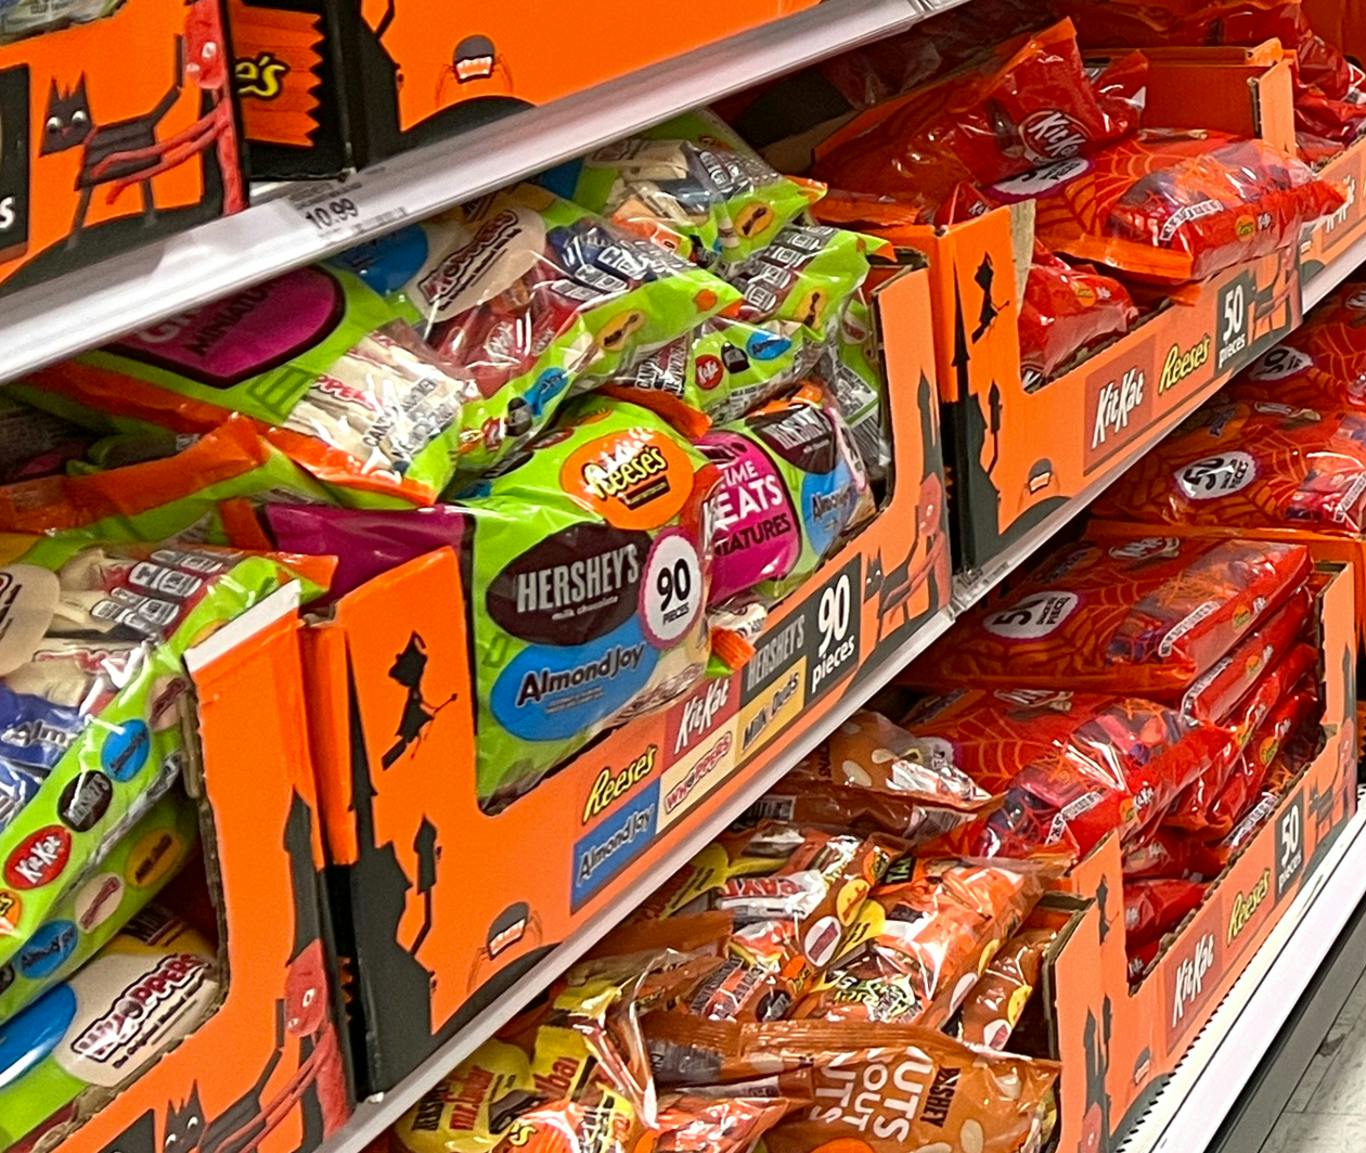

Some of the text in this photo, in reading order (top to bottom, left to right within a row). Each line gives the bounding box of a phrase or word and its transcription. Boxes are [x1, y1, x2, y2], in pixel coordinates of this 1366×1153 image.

[305, 198, 359, 231] 10.99
[1223, 285, 1243, 342] 50
[1158, 333, 1211, 396] Reese's
[1218, 334, 1246, 369] pieces
[517, 544, 640, 613] HERSHEY'S
[657, 559, 690, 610] 90
[663, 602, 690, 625] PIECES
[818, 574, 849, 658] 90
[746, 615, 804, 691] HERSHEY'S
[812, 634, 855, 693] pieces
[582, 745, 658, 825] Reese's
[1281, 805, 1299, 868] 50
[1227, 868, 1270, 948] Reese's
